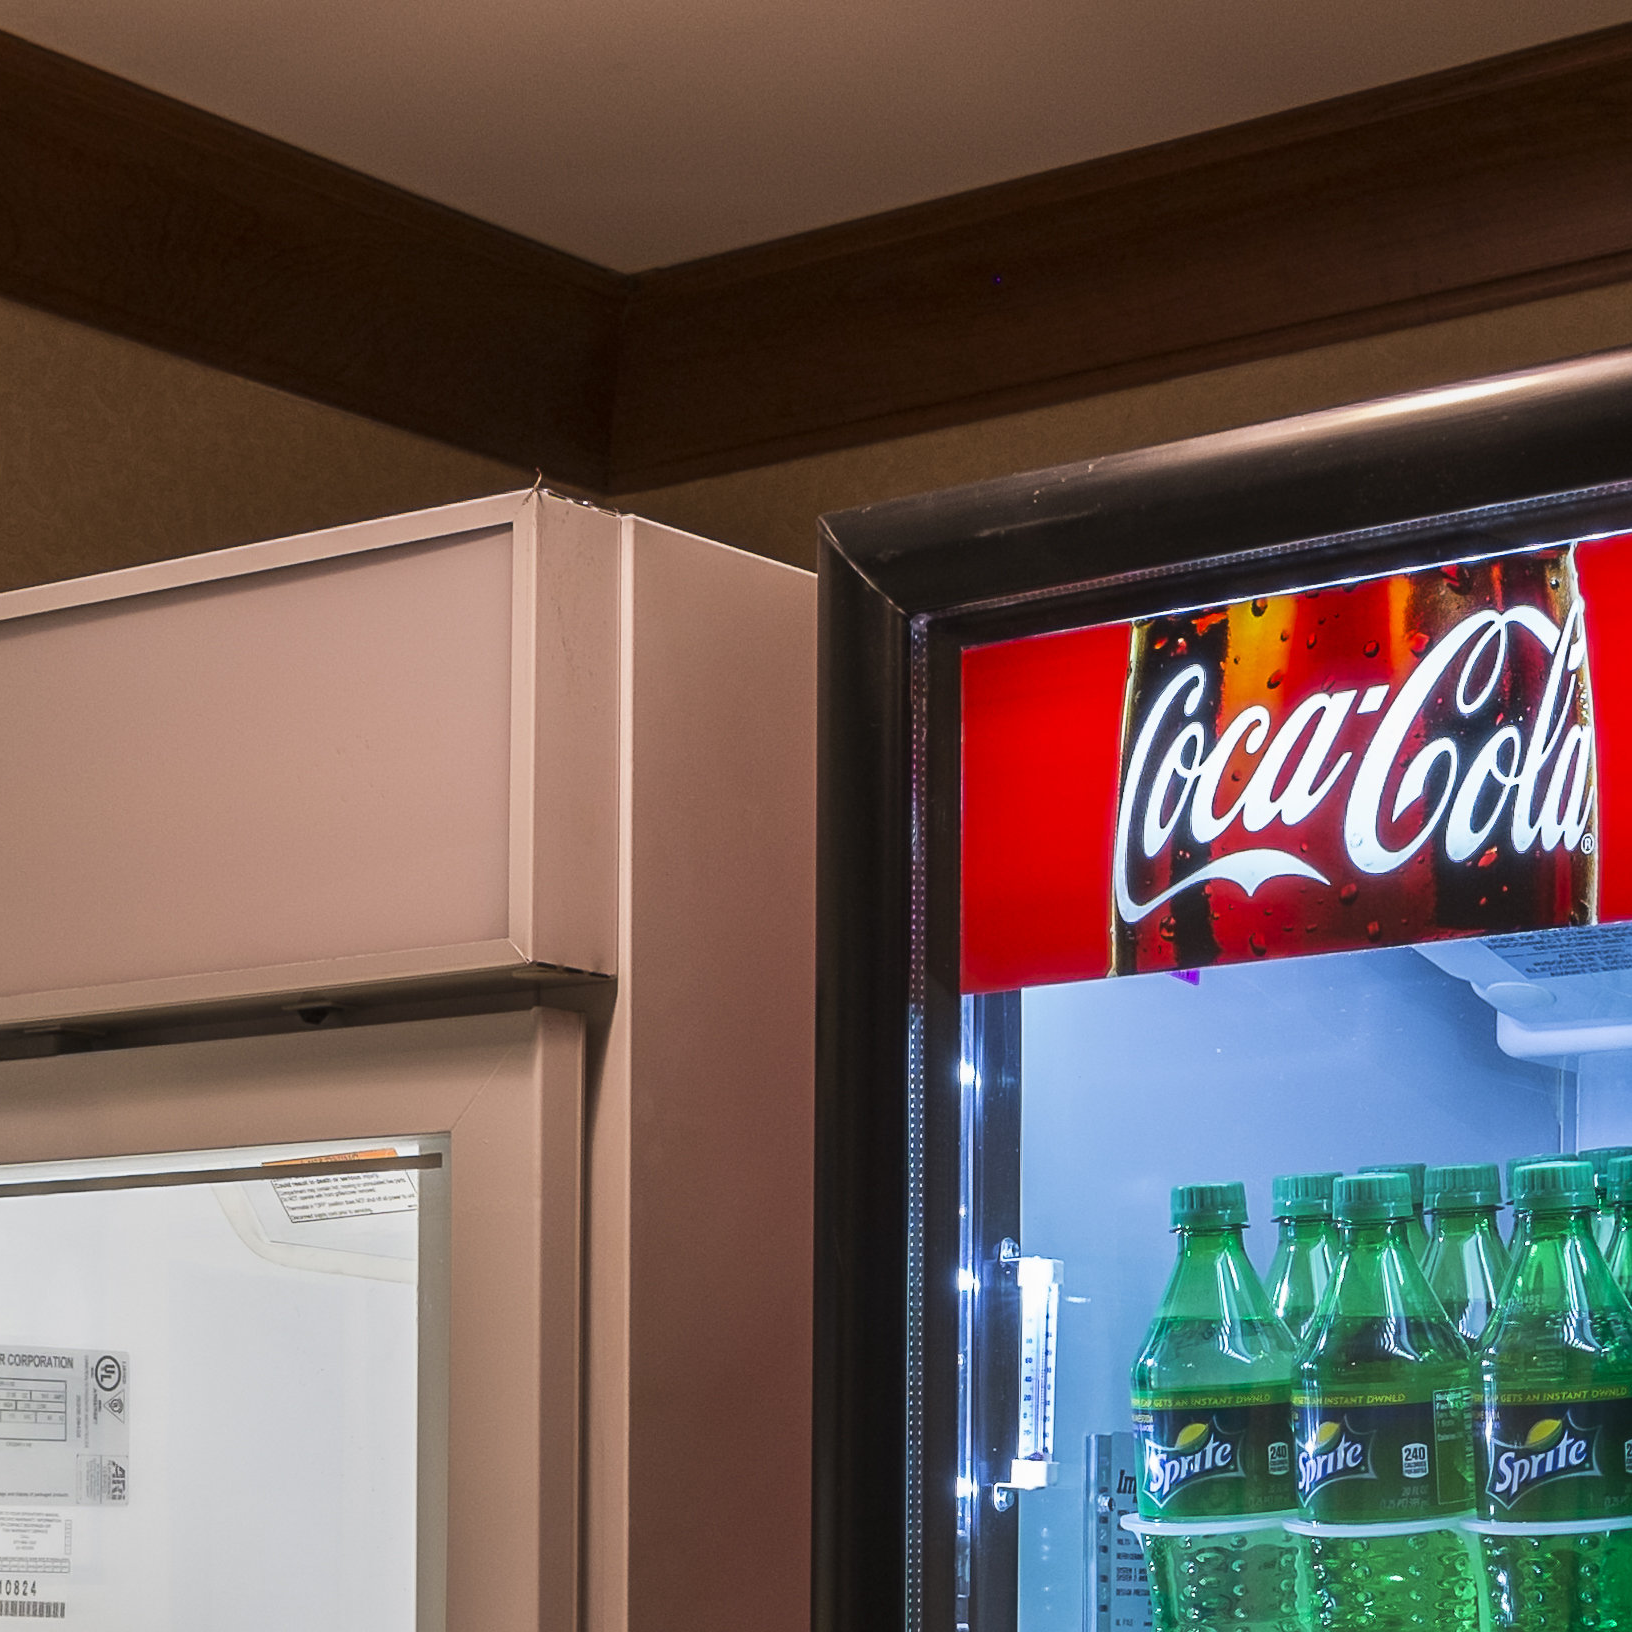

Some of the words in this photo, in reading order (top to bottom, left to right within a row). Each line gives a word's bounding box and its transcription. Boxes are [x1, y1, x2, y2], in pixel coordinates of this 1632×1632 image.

[1113, 596, 1593, 923] Coca-Cola
[8, 1353, 74, 1369] CORPORATION
[100, 1364, 115, 1382] UL
[1190, 1395, 1233, 1407] INSTANT
[1323, 1396, 1363, 1405] INSTANT
[1366, 1393, 1406, 1403] DWNLD
[1501, 1394, 1522, 1402] GETS
[1526, 1393, 1540, 1401] AN
[1543, 1391, 1590, 1401] INSTANT
[1591, 1387, 1628, 1399] DWNLD
[1270, 1445, 1287, 1459] 240
[1404, 1447, 1426, 1461] 240
[1149, 1433, 1232, 1497] Sprite
[1298, 1432, 1363, 1494] Sprite
[1495, 1430, 1587, 1496] Sprite
